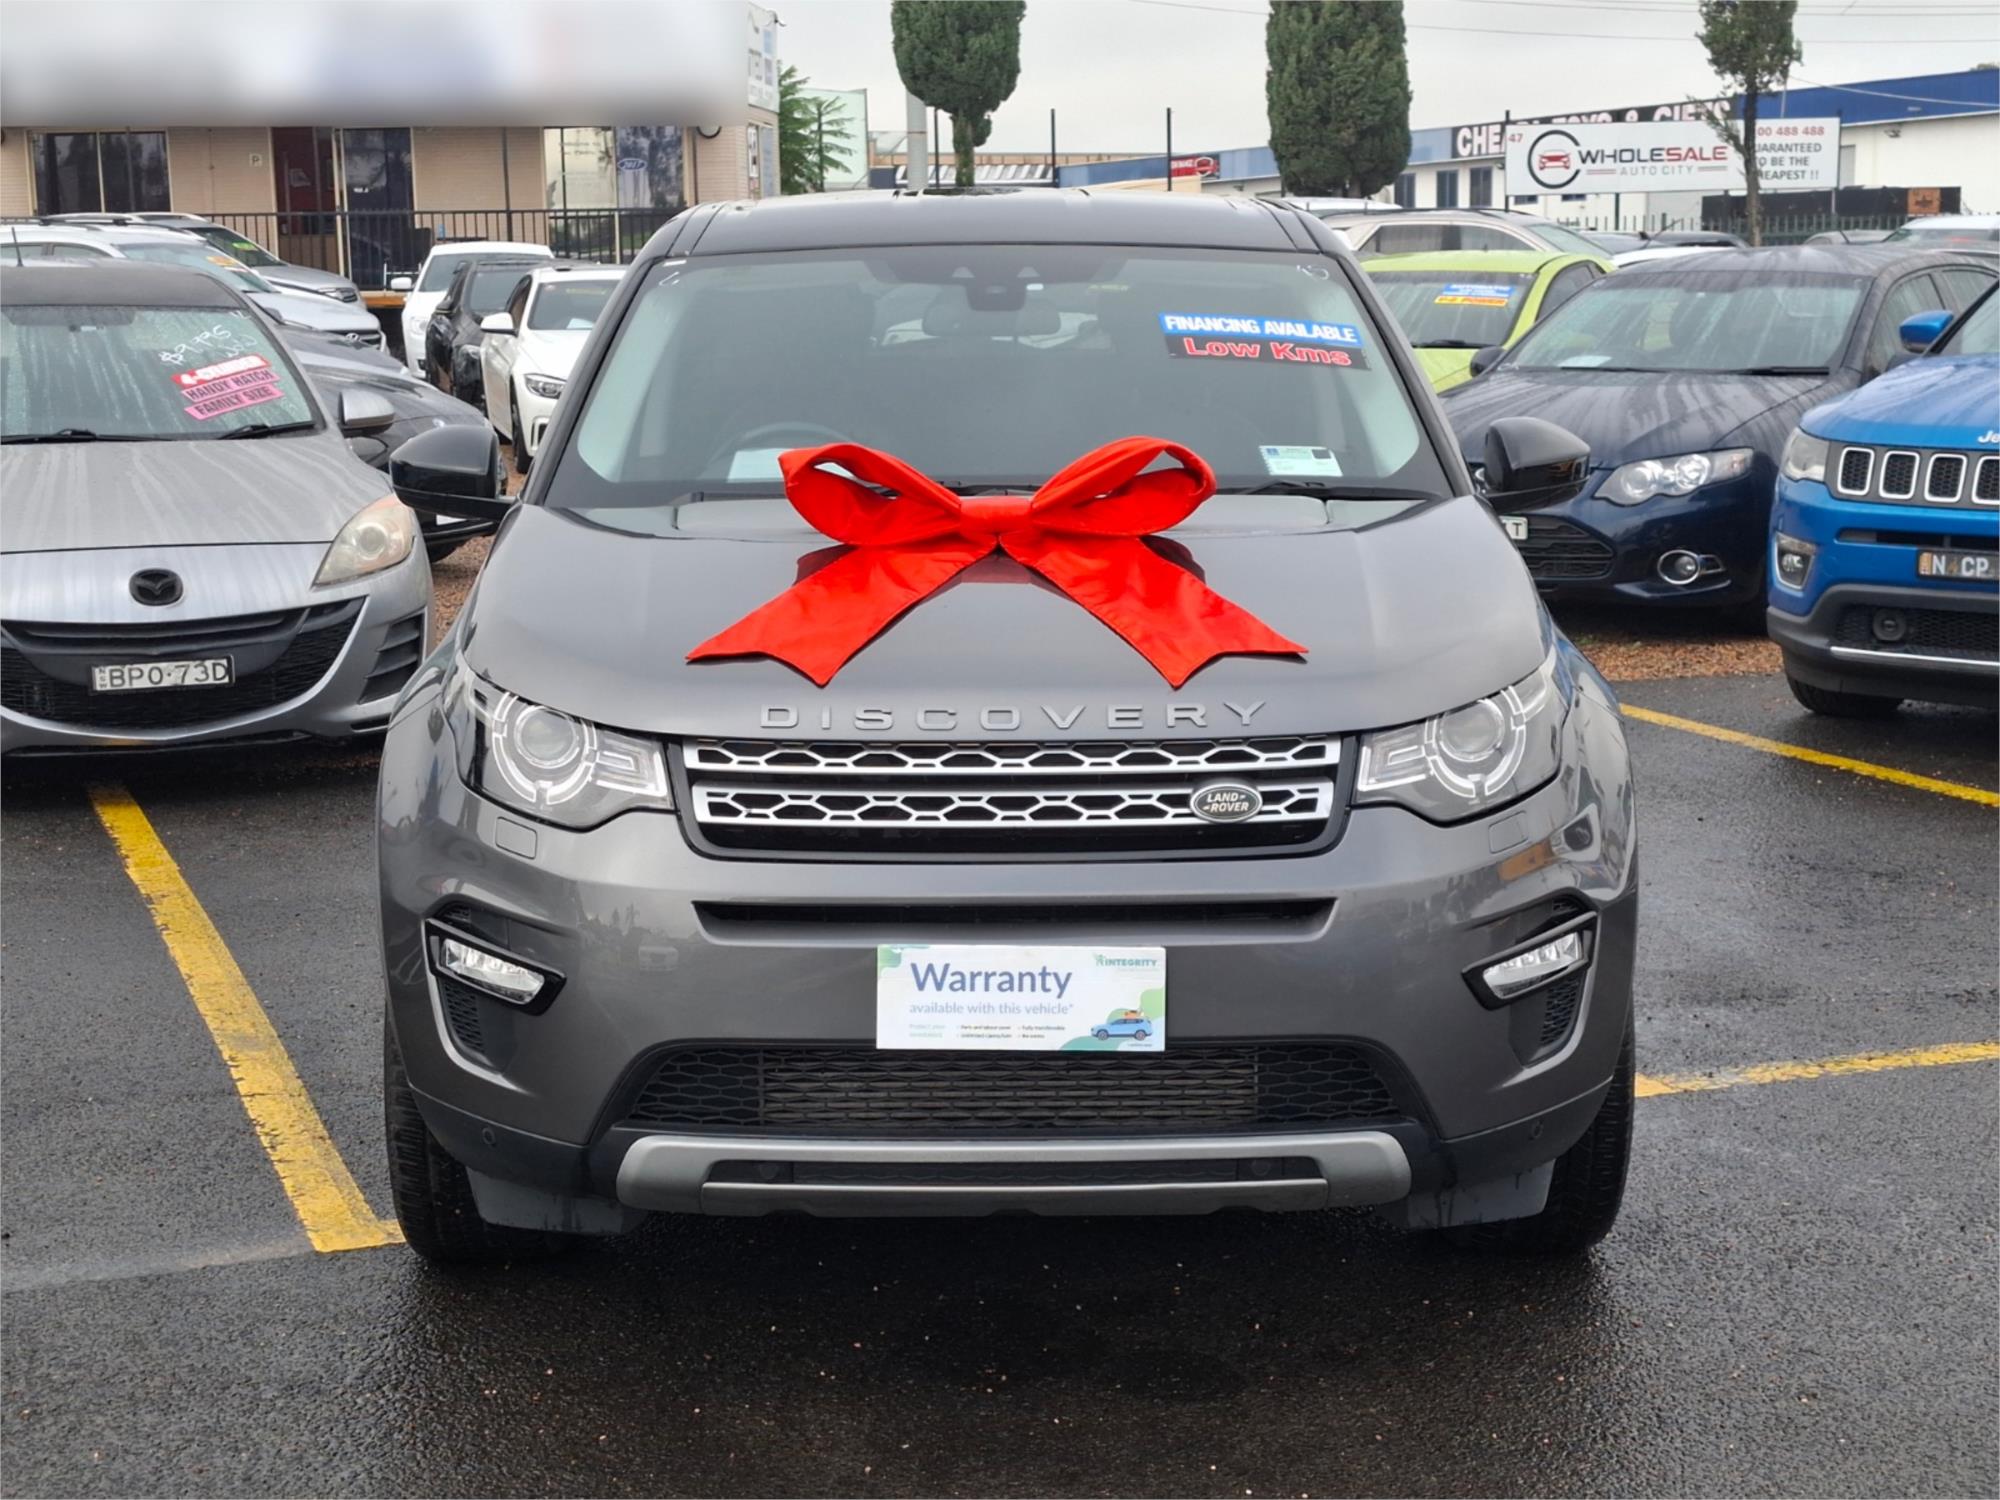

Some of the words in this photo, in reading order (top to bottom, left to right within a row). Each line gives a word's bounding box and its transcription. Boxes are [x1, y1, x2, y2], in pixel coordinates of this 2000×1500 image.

[1508, 133, 1523, 143] 47
[1776, 126, 1799, 136] 488
[1802, 126, 1825, 136] 488
[1578, 146, 1728, 164] WHOLESALE
[1756, 143, 1822, 153] UARANTEED
[1771, 156, 1784, 167] BE
[1789, 156, 1809, 166] THE
[1620, 166, 1656, 176] AUTO
[1661, 165, 1694, 176] CITY
[1164, 315, 1260, 335] FINANCING
[1264, 320, 1357, 343] AVAILABLE
[1183, 337, 1260, 358] Low
[1270, 342, 1351, 366] Kms
[186, 380, 231, 401] HANDY
[231, 369, 274, 388] HATCH
[195, 394, 243, 416] FAMILY
[243, 386, 273, 401] SIZE
[760, 700, 1266, 731] DISCOVERY
[1105, 958, 1158, 967] INTEGRITY
[910, 962, 1072, 999] Warranty
[910, 1001, 964, 1015] available
[967, 1001, 996, 1015] with
[999, 1001, 1021, 1015] this
